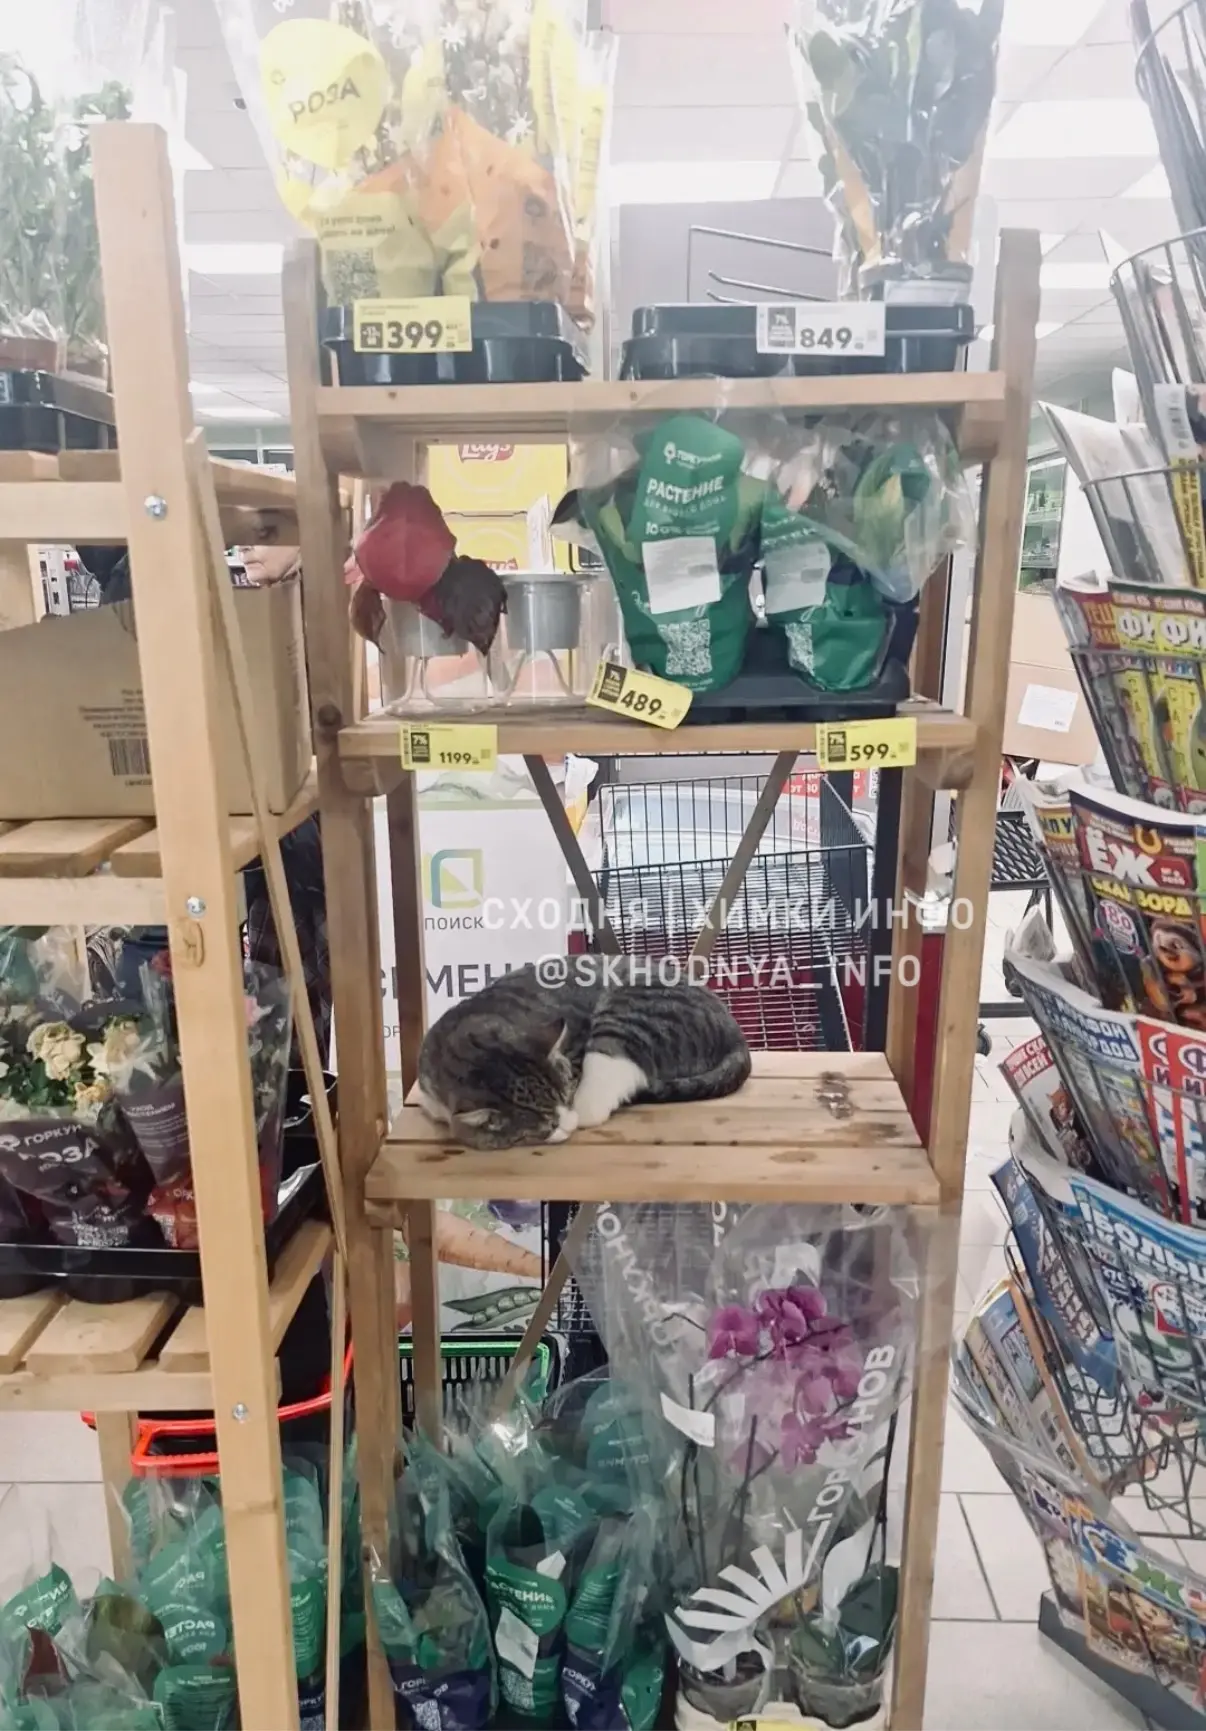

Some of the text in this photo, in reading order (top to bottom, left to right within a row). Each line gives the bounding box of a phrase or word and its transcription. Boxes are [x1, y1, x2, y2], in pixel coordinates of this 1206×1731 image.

[288, 76, 361, 124] РОЗА
[387, 319, 444, 349] 399
[800, 326, 853, 350] 849
[646, 475, 725, 505] РАСТЕНИЕ
[621, 690, 663, 716] 489
[440, 751, 472, 765] 1199
[850, 743, 889, 762] 599
[424, 916, 485, 931] ПОИСК
[18, 1137, 99, 1162] ОЗА
